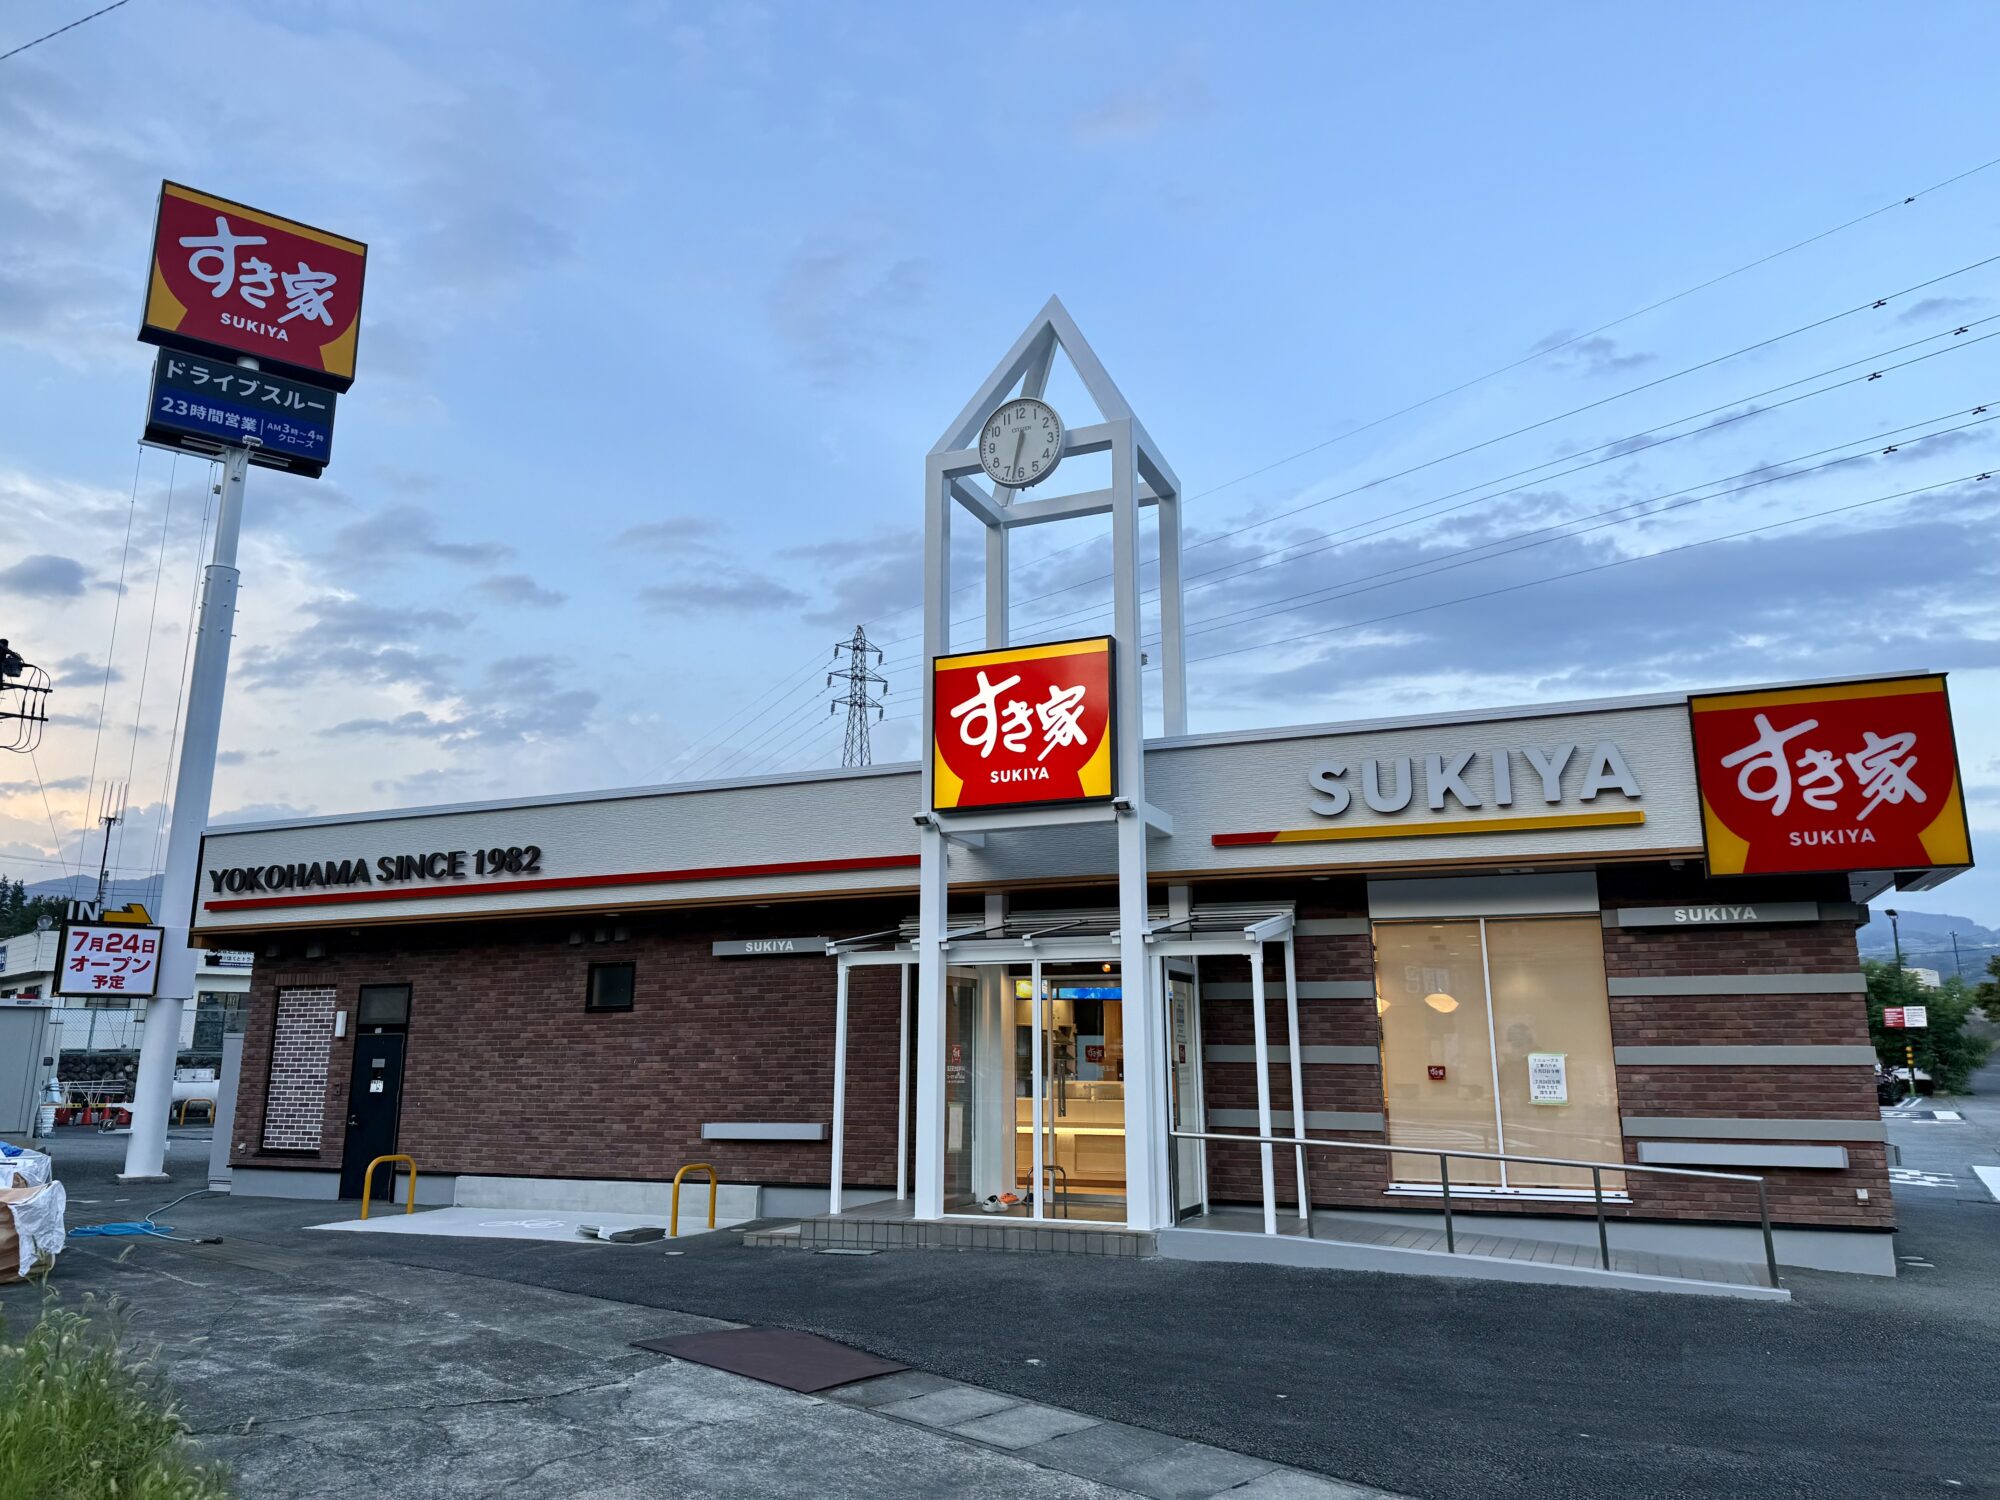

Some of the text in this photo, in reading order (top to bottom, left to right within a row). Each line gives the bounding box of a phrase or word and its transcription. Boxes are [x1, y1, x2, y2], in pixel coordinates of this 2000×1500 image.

[179, 216, 337, 326] すき家
[220, 313, 289, 342] SUKIYA
[167, 359, 326, 411] ドライブスルー
[161, 397, 257, 432] 23時間営業
[1003, 413, 1011, 425] 11
[1015, 407, 1026, 420] 12
[1033, 408, 1037, 420] 1
[1042, 417, 1049, 428] 2
[991, 426, 1000, 438] 10
[1046, 432, 1054, 443] 3
[278, 433, 315, 448] クローズ
[989, 443, 996, 454] 9
[1042, 448, 1050, 459] 4
[992, 457, 1000, 468] 8
[1031, 460, 1039, 472] 5
[1004, 466, 1011, 477] 7
[1017, 467, 1025, 478] 6
[950, 671, 1088, 762] すき家
[1720, 713, 1927, 821] すき家
[990, 767, 1050, 784] SUKIYA
[1308, 739, 1642, 817] SUKIYA
[1789, 828, 1876, 847] SUKIYA
[209, 845, 542, 893] YOKOHAMA SINCE 1982
[67, 901, 99, 922] IN
[1674, 906, 1758, 922] SUKIYA
[72, 931, 156, 954] 7月24日
[745, 940, 794, 952] SUKIYA
[70, 956, 151, 974] オープン
[92, 975, 126, 990] 予定
